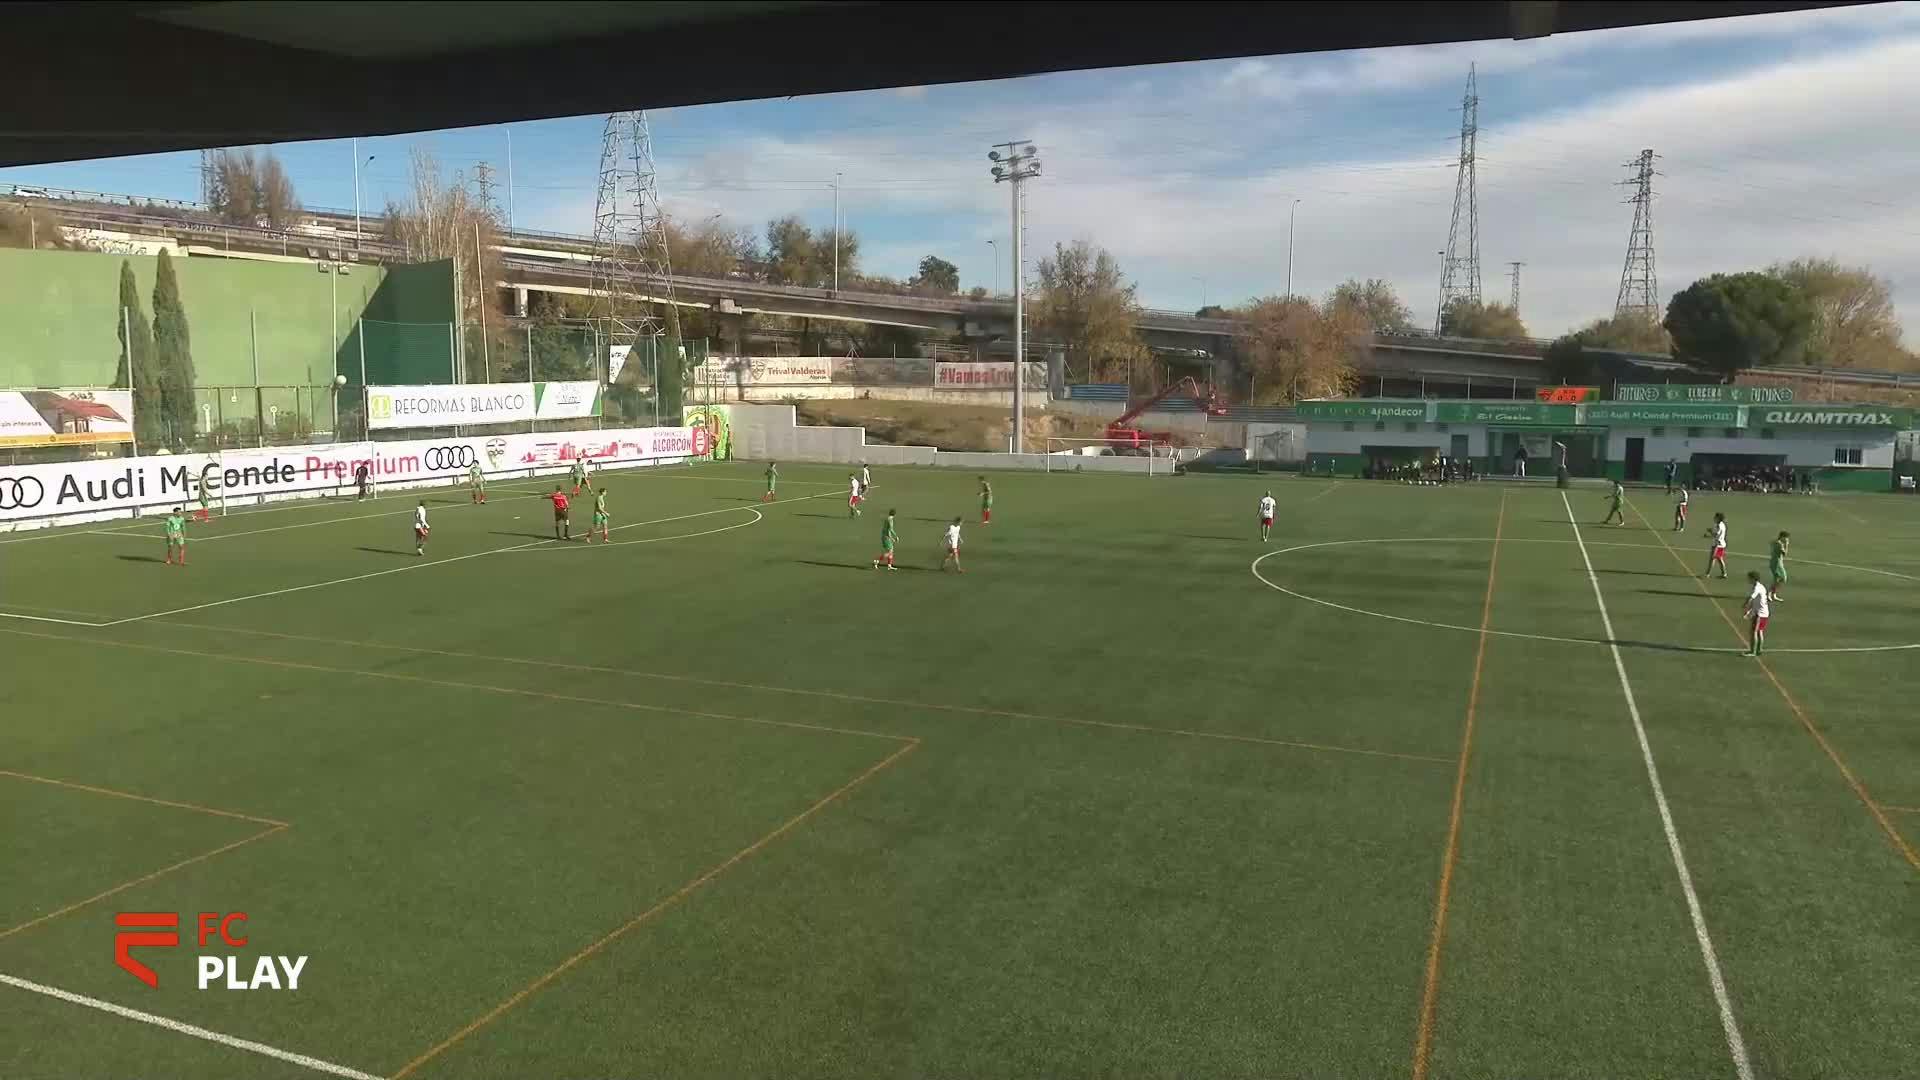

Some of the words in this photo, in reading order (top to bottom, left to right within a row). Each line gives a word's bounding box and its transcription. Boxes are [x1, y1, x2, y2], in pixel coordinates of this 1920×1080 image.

[767, 367, 790, 375] Trival
[791, 367, 826, 376] Valderas
[395, 397, 466, 416] REFORMAS
[471, 394, 525, 413] BLANCO
[1765, 411, 1893, 425] QUAMTRAX
[56, 468, 145, 505] Audi
[305, 451, 420, 481] Premium
